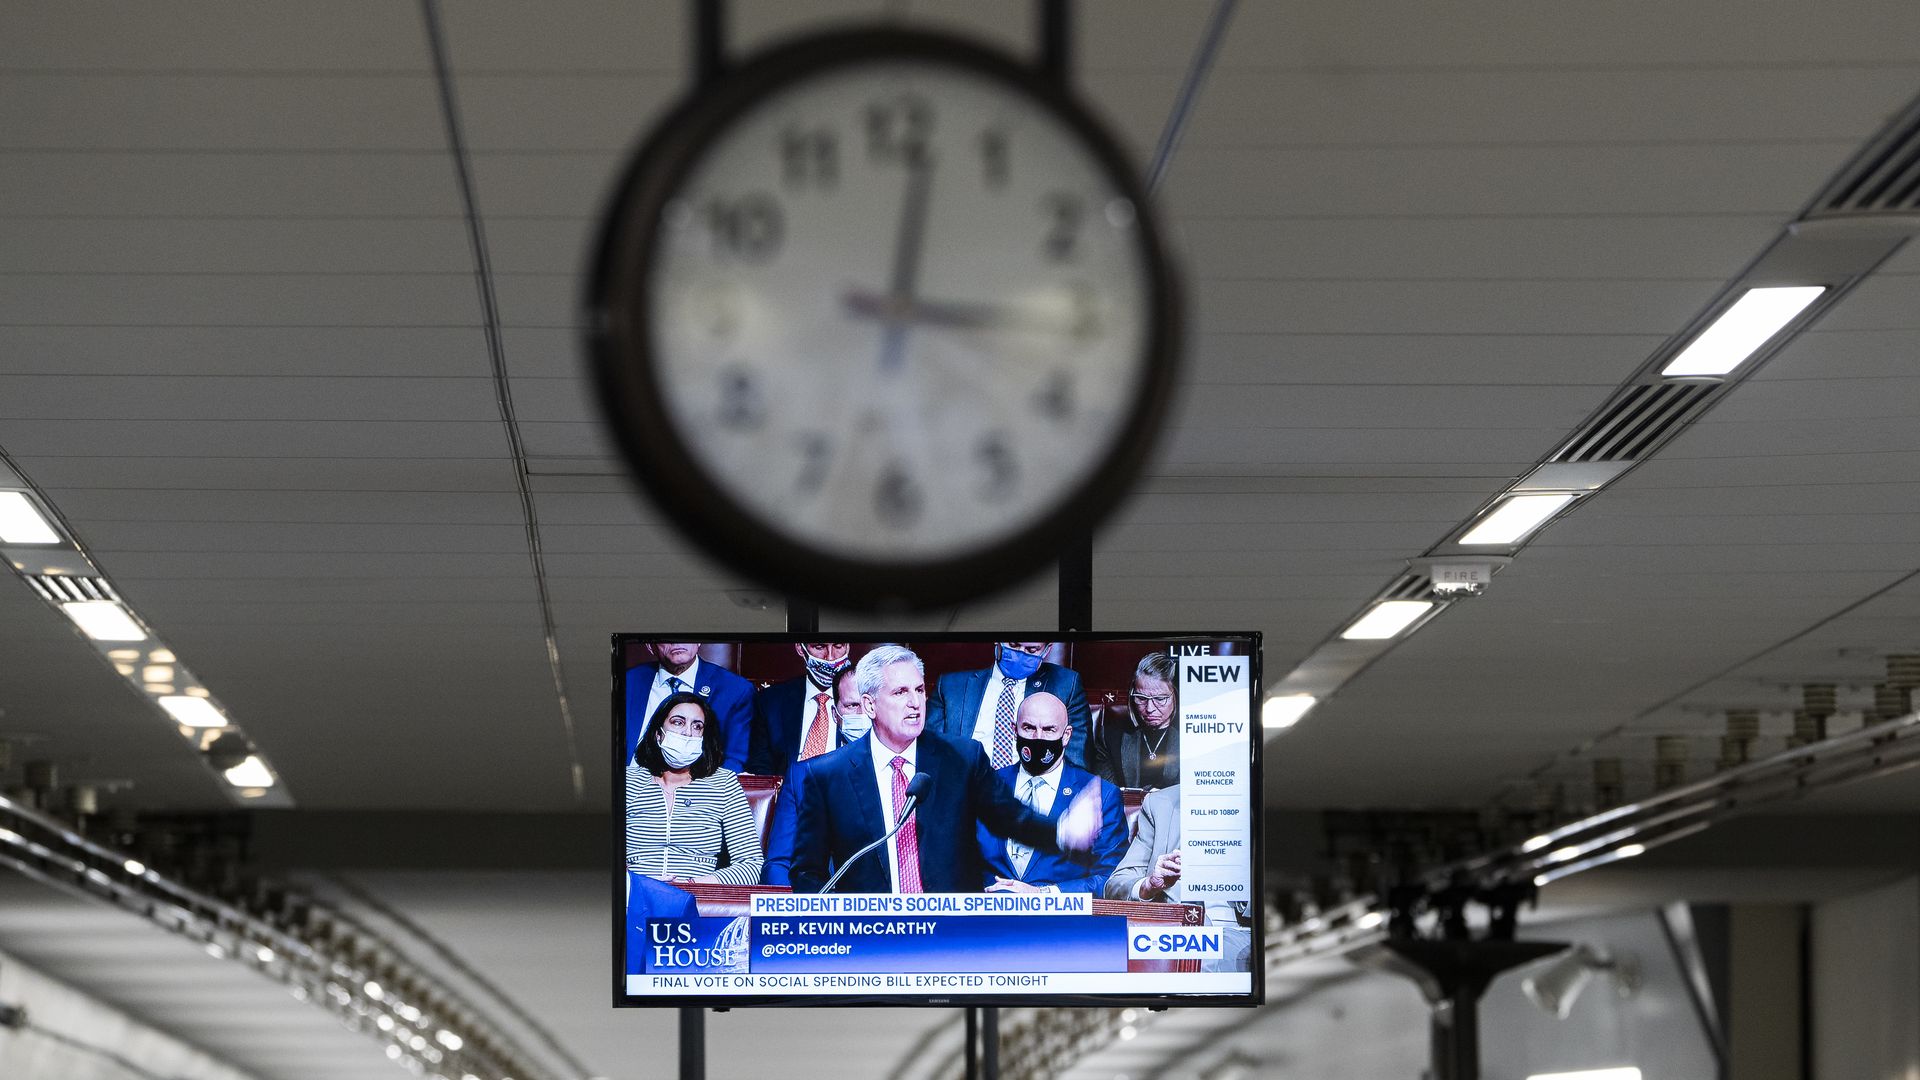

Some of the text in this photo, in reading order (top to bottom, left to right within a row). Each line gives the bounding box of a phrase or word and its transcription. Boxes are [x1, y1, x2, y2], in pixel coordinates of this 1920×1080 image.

[866, 97, 936, 172] 12
[779, 123, 842, 192] 11
[978, 125, 1012, 190] 1
[706, 193, 786, 265] 10
[1040, 190, 1085, 265] 2
[716, 360, 767, 434] 8
[1029, 365, 1078, 427] 4
[792, 427, 836, 497] 7
[973, 427, 1023, 500] 5
[872, 458, 926, 531] 6
[1444, 571, 1478, 580] FIRE
[1170, 645, 1211, 657] LIVE
[1187, 665, 1241, 683] NEW
[1213, 770, 1236, 778] COLOR
[1188, 884, 1244, 892] UN43J5000
[756, 896, 1084, 912] PRESIDENT BIDEN'S SOCIAL SPENDING PLAN
[650, 923, 697, 944] U.S.
[761, 921, 937, 935] REP. KEVIN McCARTHY
[653, 945, 737, 967] HOUSE
[761, 943, 852, 958] @GOPLeader
[652, 975, 1049, 988] FINAL VOTE ON SOCIAL SPENDING BILL EXPECTED TONIGHT
